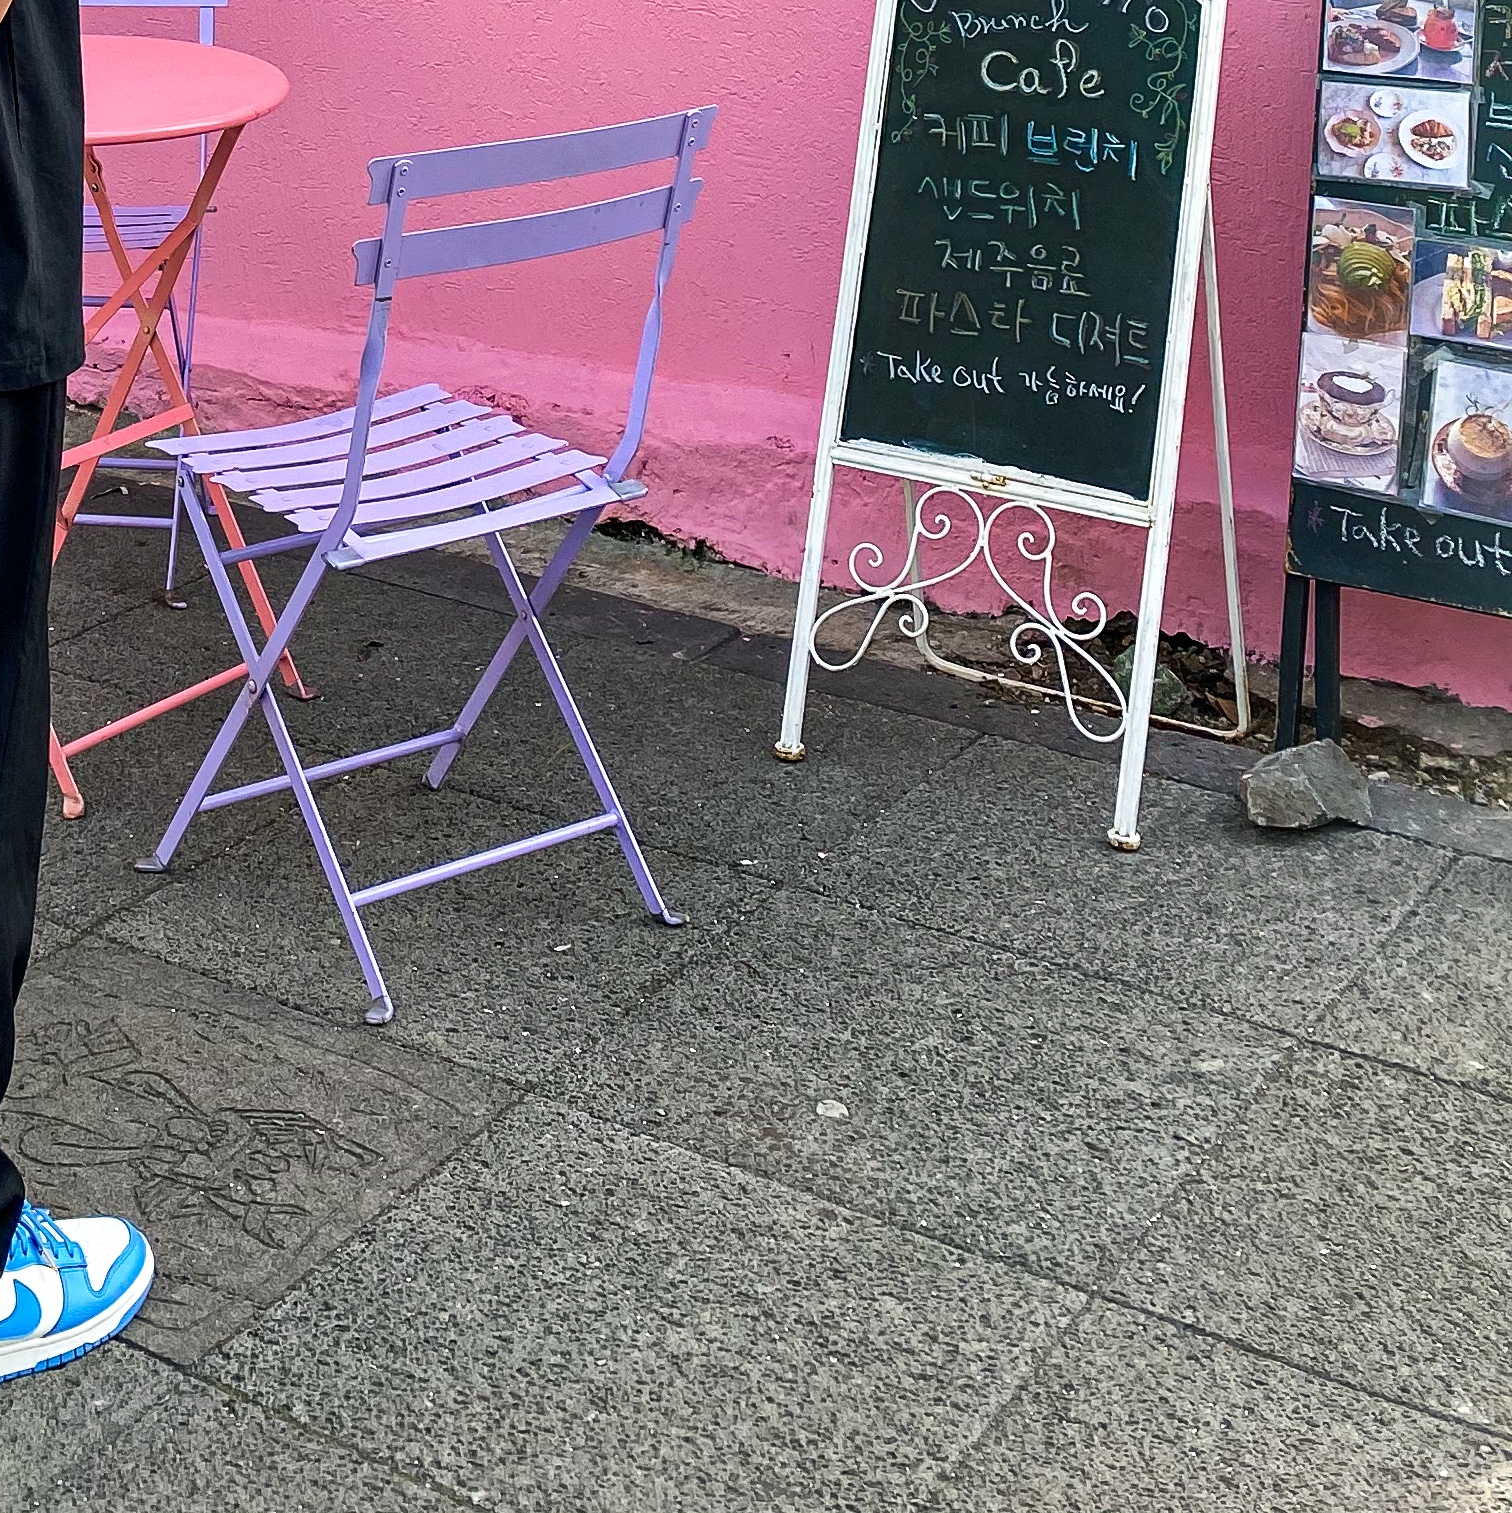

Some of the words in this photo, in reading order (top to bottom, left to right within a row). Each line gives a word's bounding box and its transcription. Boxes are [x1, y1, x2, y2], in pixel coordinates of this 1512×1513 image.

[980, 39, 1105, 99] Cafe
[923, 113, 1009, 157] 커피
[1026, 120, 1138, 181] 브런치
[917, 176, 1081, 231] 샌드위치
[934, 239, 1092, 297] 제주음료
[895, 288, 1033, 344] 파스타
[876, 349, 945, 383] Take
[952, 356, 1006, 394] out
[1329, 504, 1424, 558] Take
